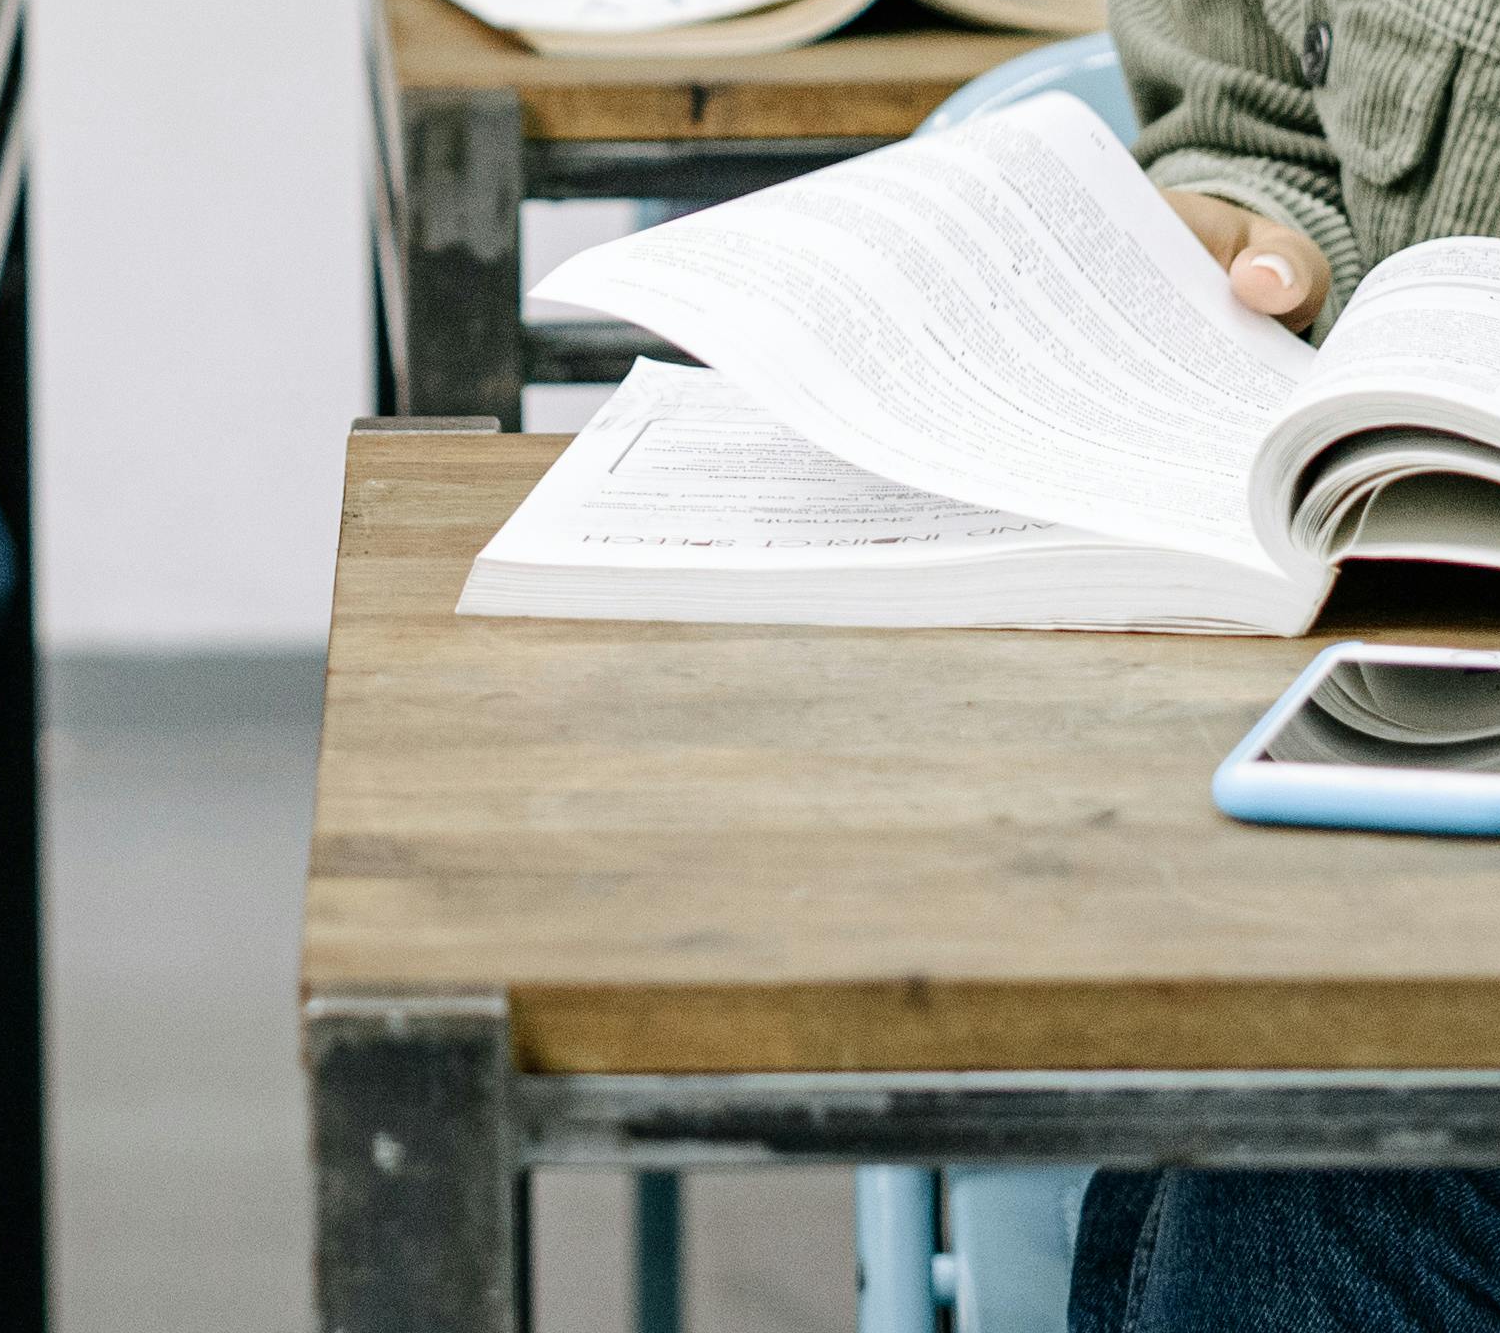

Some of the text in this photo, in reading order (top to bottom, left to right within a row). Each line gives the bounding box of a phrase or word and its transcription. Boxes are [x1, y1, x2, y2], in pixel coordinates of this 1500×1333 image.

[753, 515, 914, 525] Statements
[582, 522, 1058, 548] AND INDIRECT SPEECH
